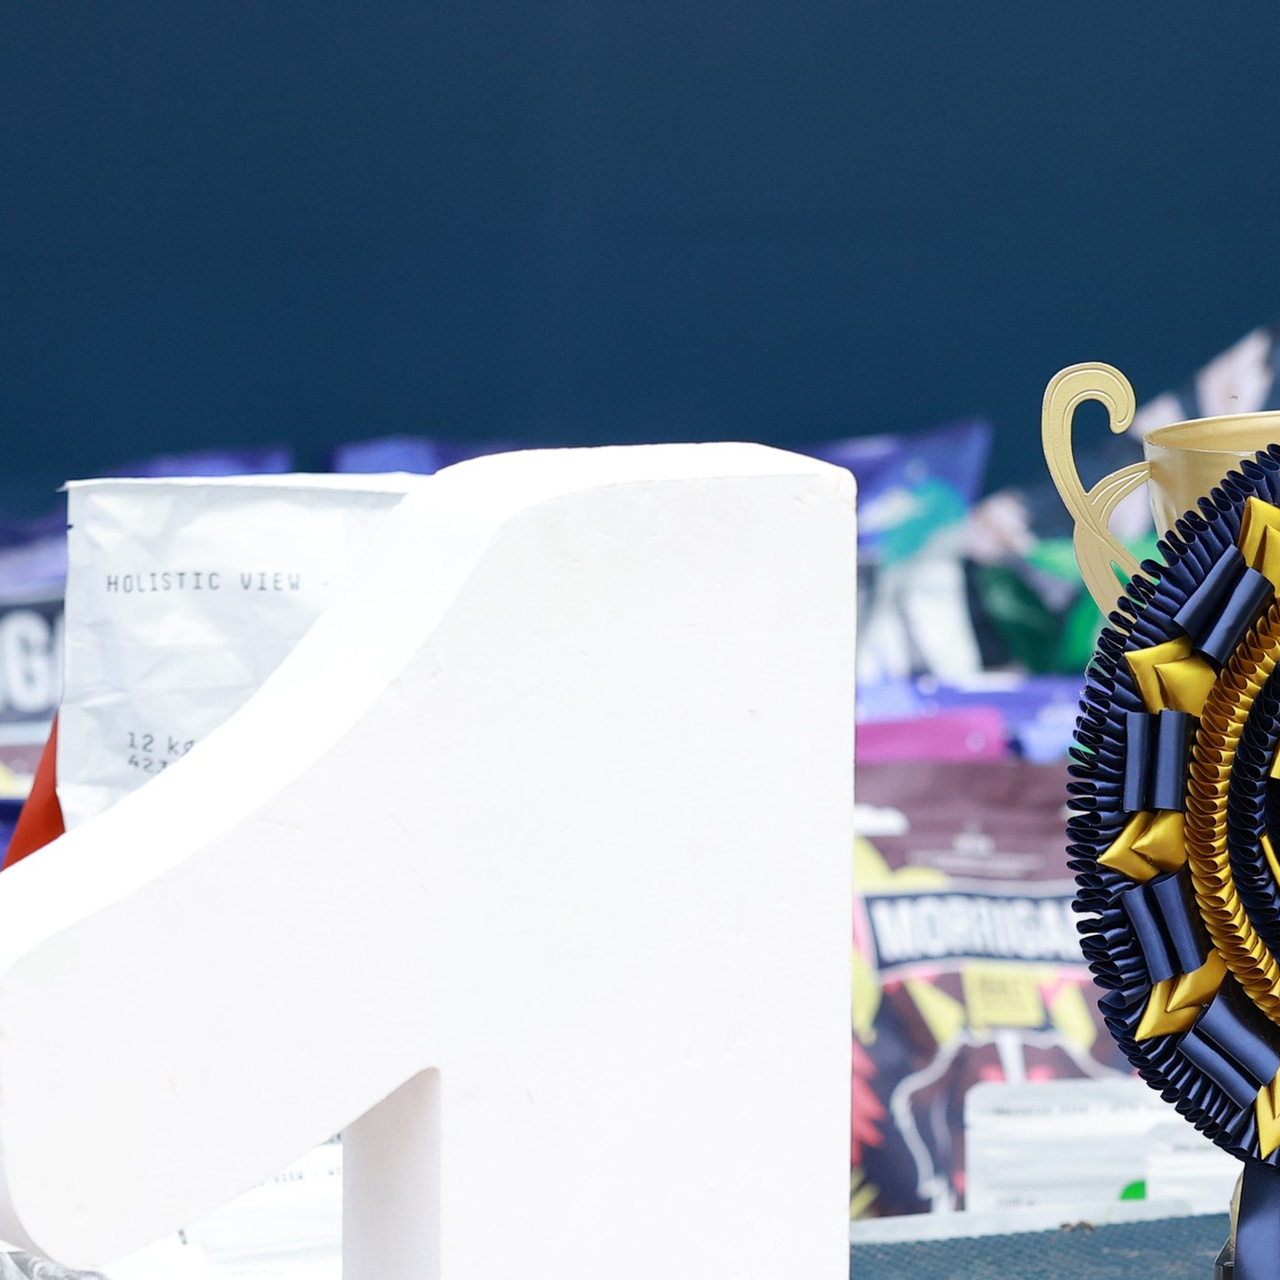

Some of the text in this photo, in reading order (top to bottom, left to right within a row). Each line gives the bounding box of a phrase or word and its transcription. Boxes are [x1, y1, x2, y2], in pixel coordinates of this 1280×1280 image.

[106, 572, 301, 593] HOLISTIC VIEW
[127, 731, 195, 755] 12 kg
